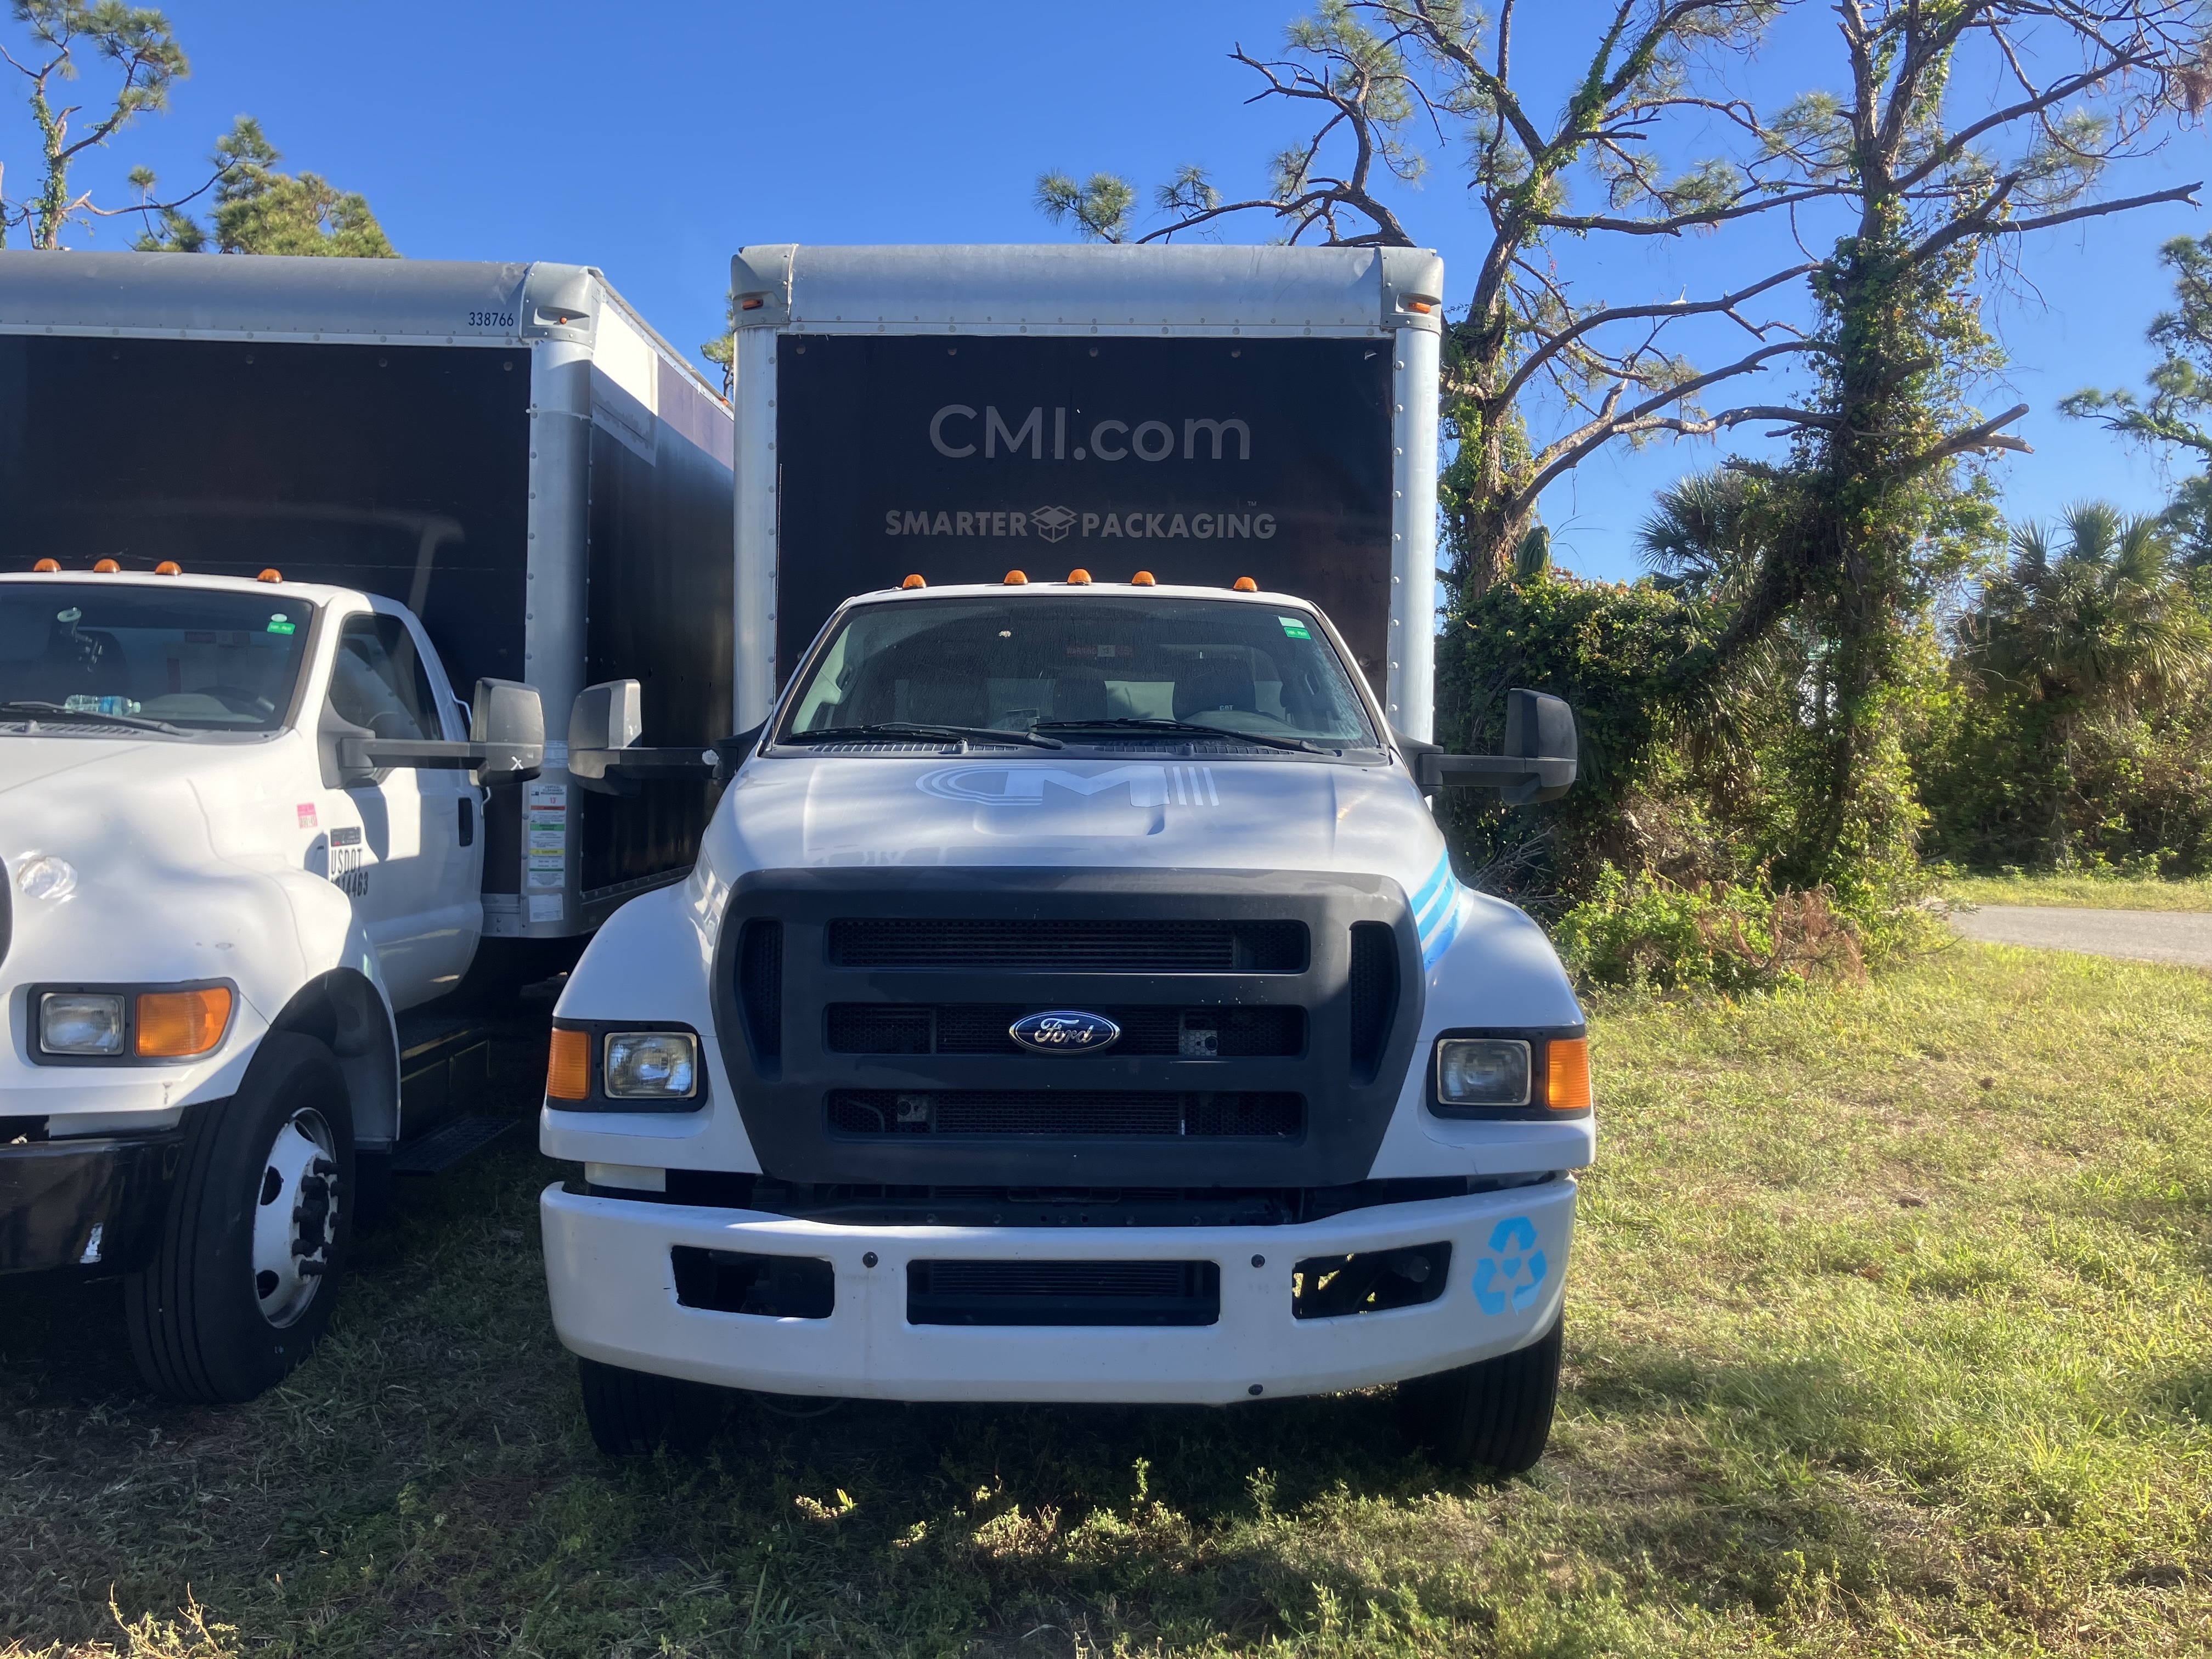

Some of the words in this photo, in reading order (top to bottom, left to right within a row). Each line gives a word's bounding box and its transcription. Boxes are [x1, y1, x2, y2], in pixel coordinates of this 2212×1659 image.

[469, 312, 514, 326] 338766
[929, 404, 1251, 462] CMI.com
[885, 510, 1028, 537] SMARTER
[1084, 513, 1277, 539] PACKAGING
[331, 849, 362, 874] USDOT
[331, 871, 368, 898] 14463
[1034, 1018, 1094, 1043] Ford
